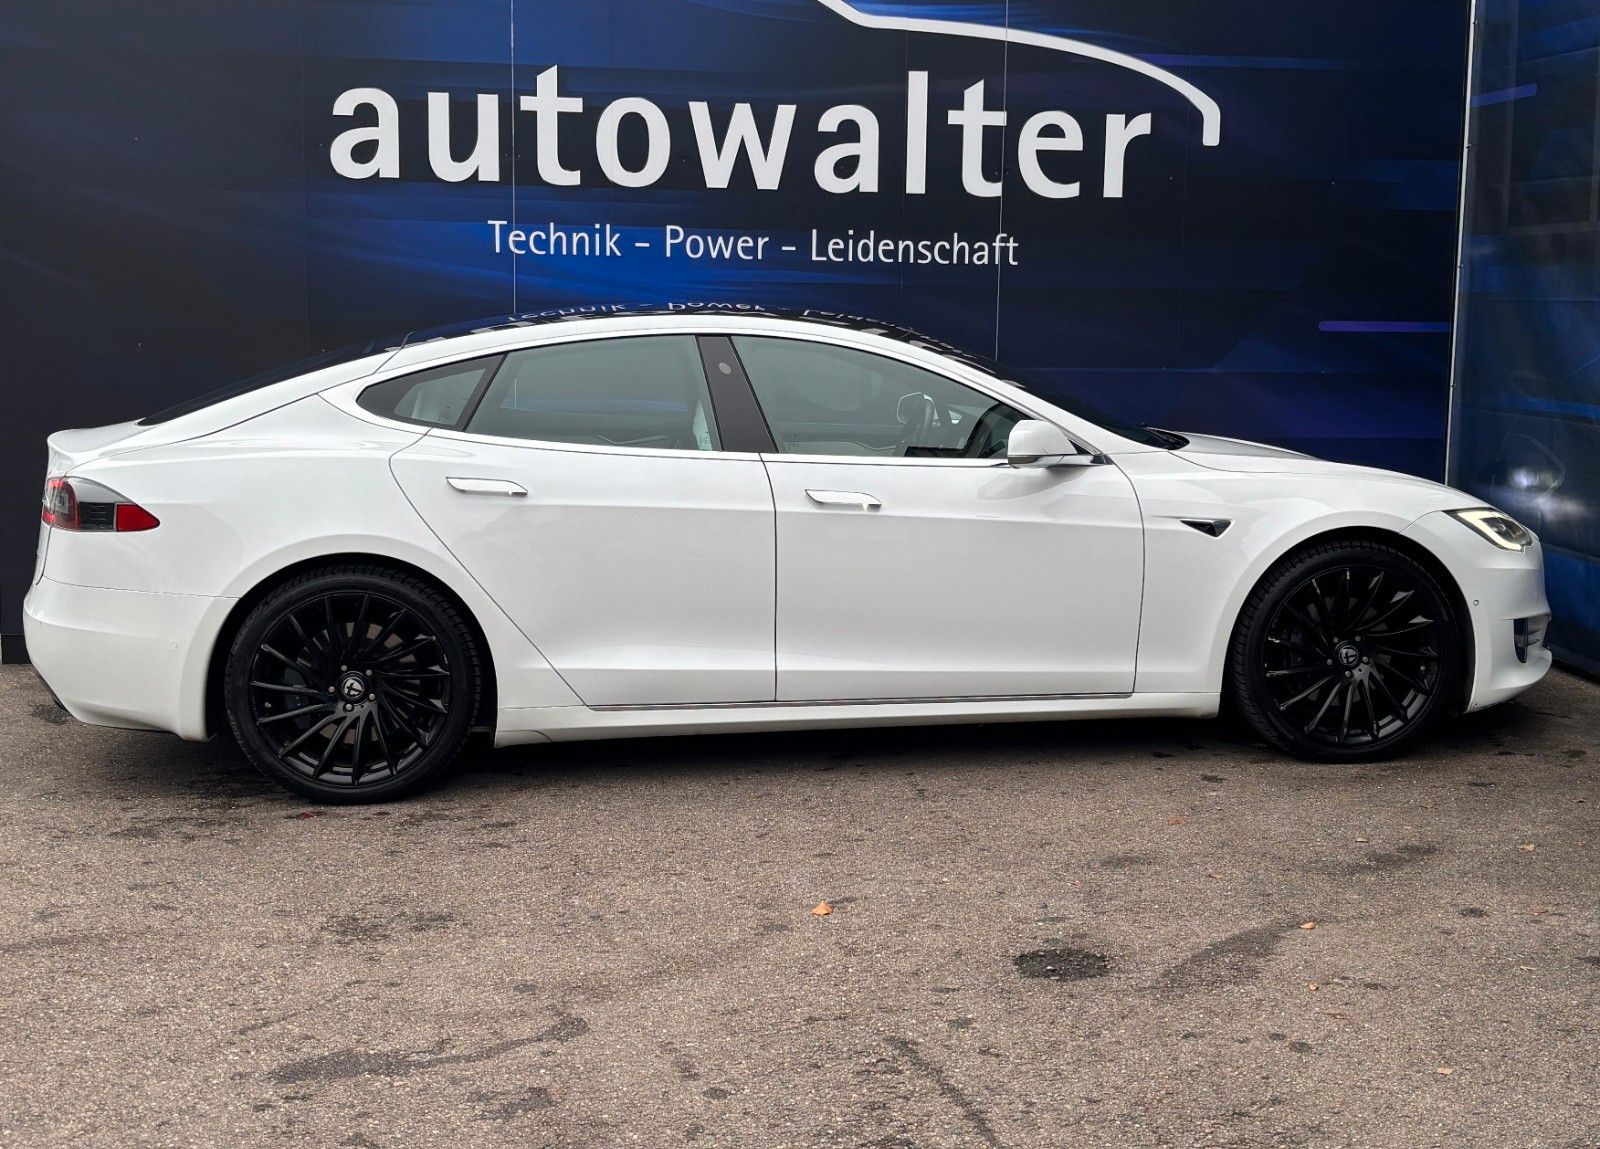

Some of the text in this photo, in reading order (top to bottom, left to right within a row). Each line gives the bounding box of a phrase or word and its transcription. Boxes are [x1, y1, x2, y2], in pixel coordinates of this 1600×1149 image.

[329, 64, 1152, 199] autowalter
[487, 219, 622, 257] Technik
[665, 224, 770, 260] Power
[811, 228, 1019, 268] Leidenschaft
